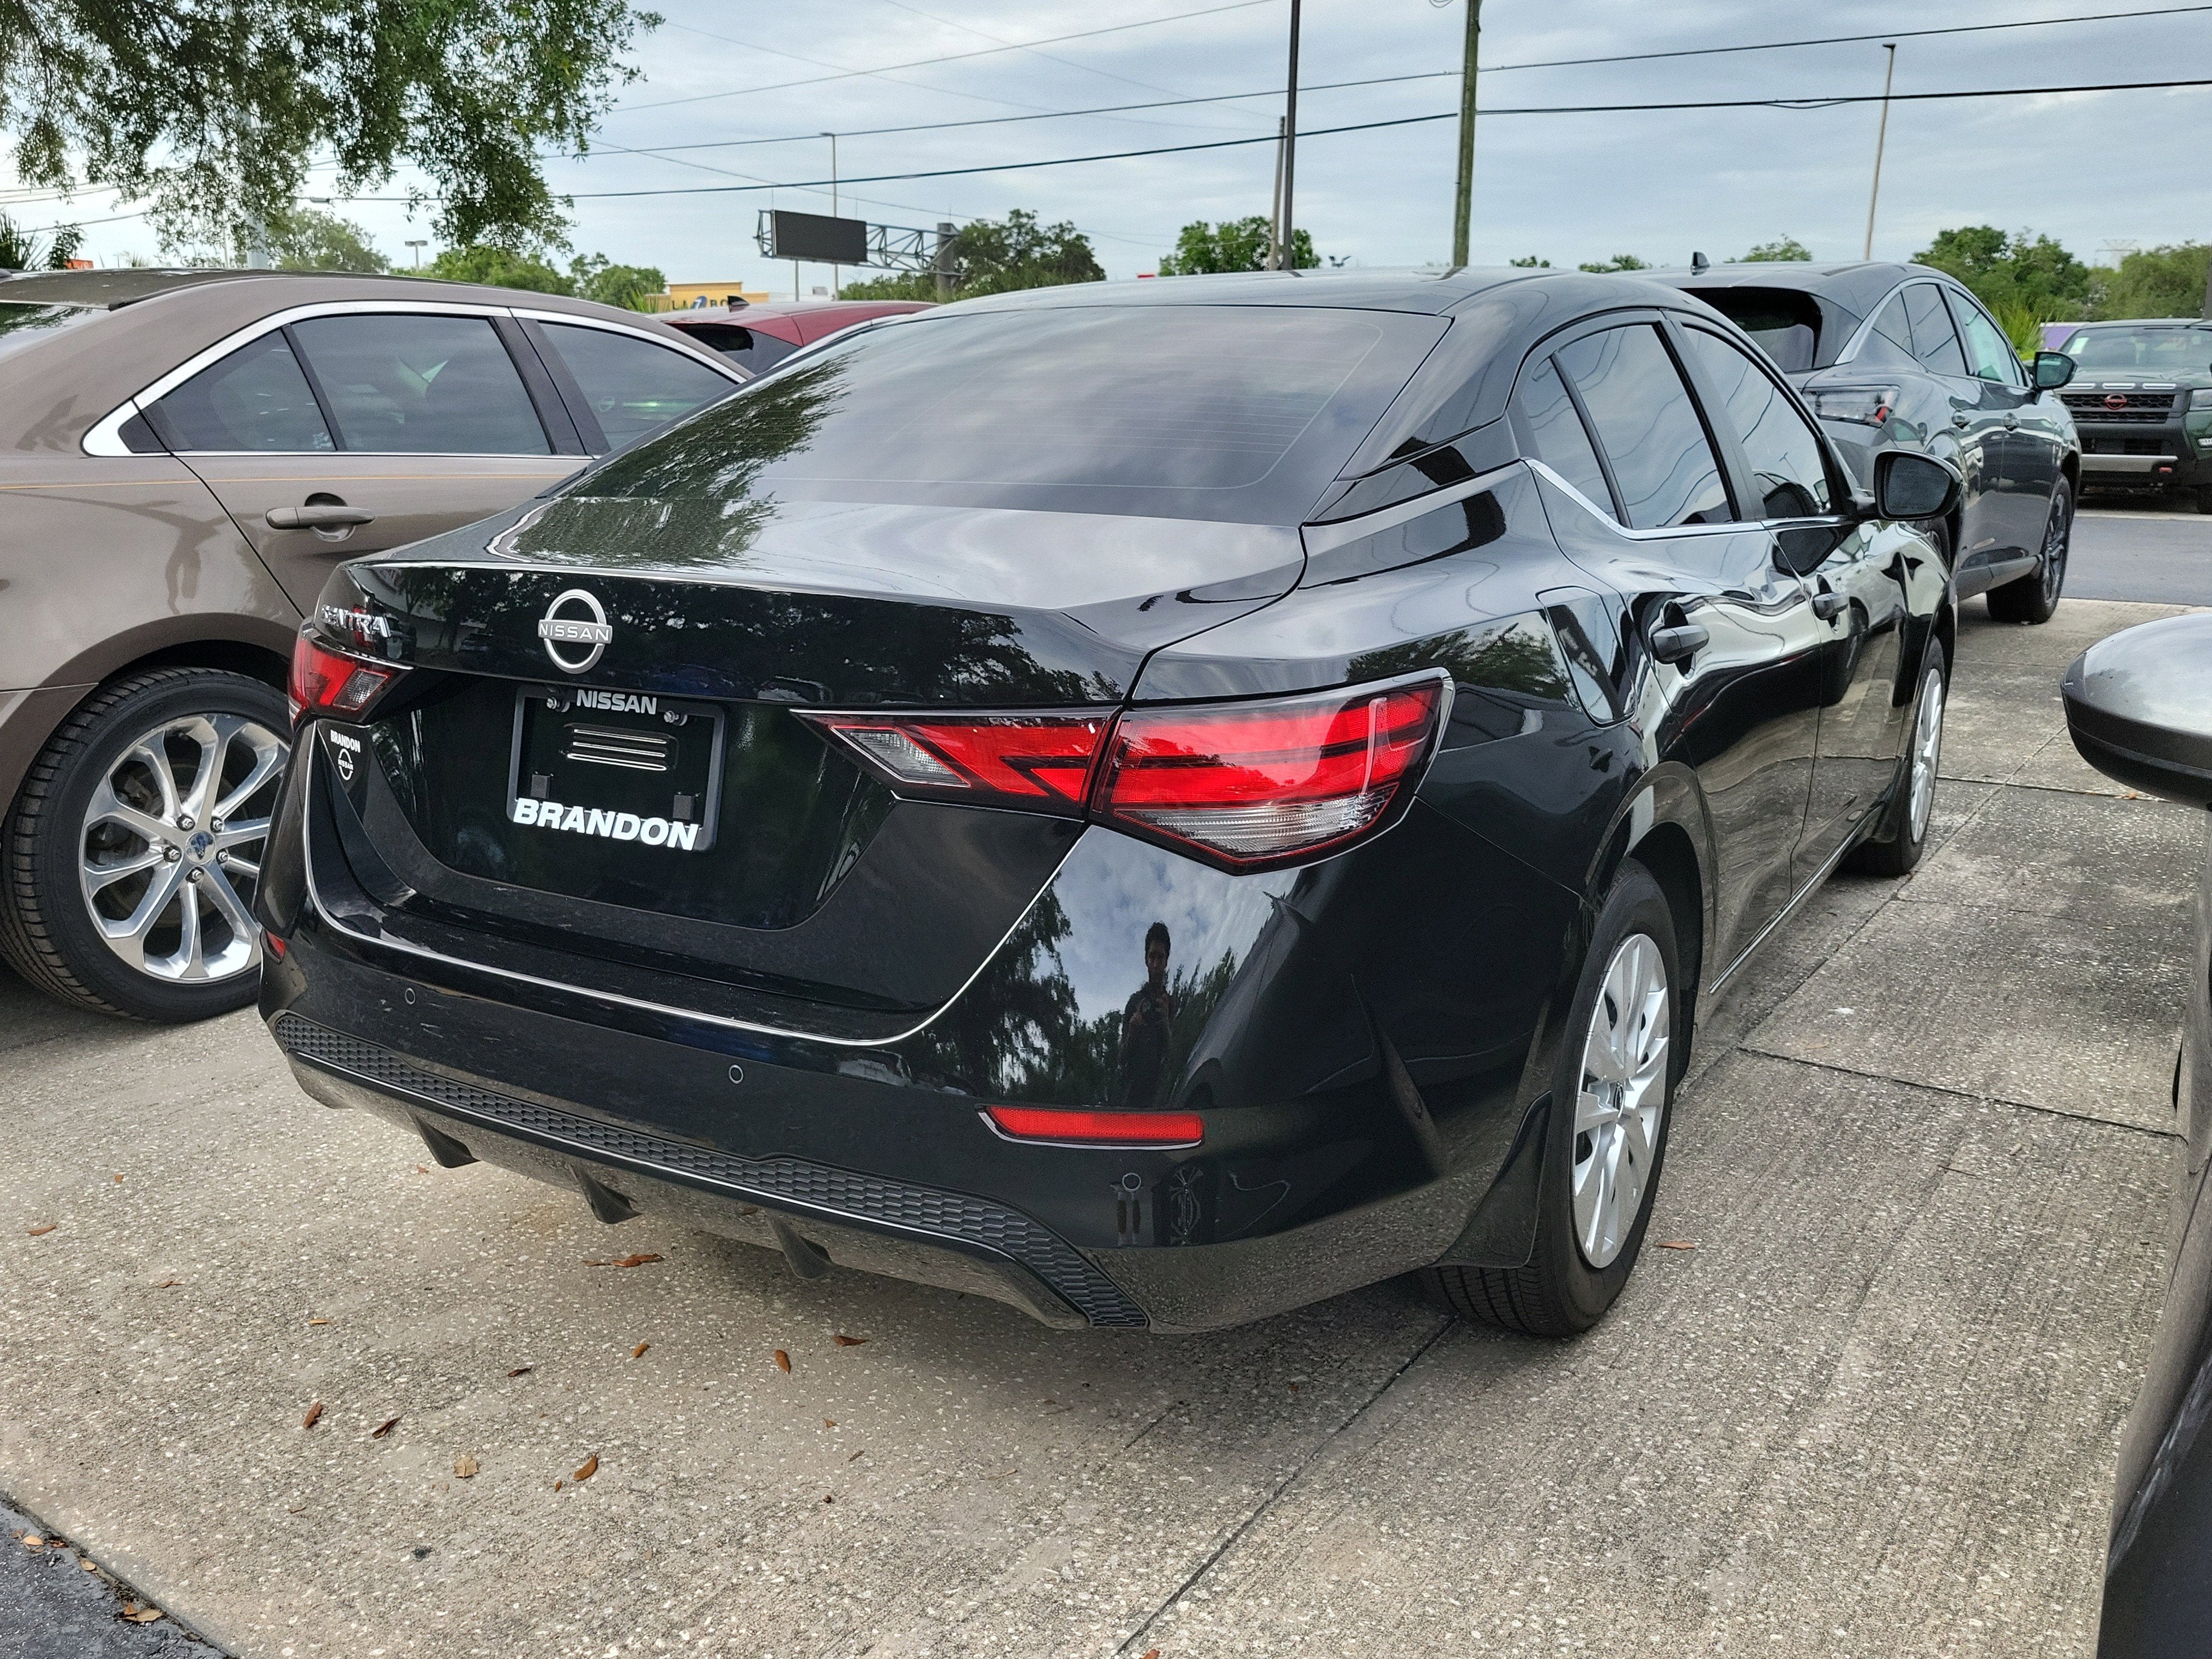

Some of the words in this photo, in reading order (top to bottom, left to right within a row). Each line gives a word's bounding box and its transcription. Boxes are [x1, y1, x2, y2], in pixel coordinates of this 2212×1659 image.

[539, 623, 609, 641] NISSAN
[577, 689, 657, 714] NISSAN
[330, 729, 361, 753] BRANDON
[514, 798, 699, 851] BRANDON
